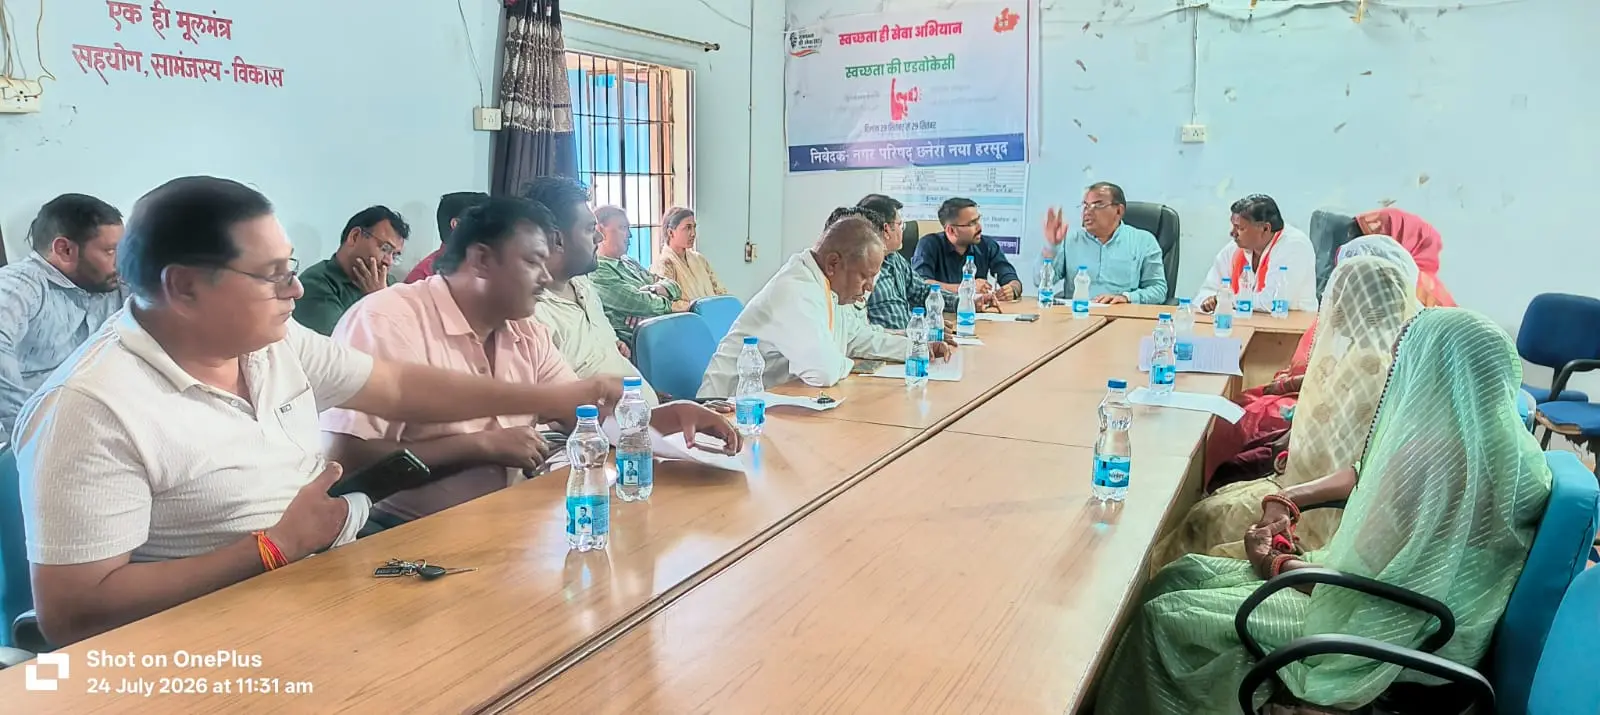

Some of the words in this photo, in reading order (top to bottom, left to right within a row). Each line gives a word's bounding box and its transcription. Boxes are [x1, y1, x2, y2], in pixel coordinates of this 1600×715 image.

[107, 0, 143, 31] एक
[151, 0, 171, 40] ही
[176, 9, 233, 45] मूलमंत्र
[838, 30, 877, 46] स्वच्छता
[879, 24, 889, 43] ही
[891, 24, 912, 41] सेवा
[915, 19, 963, 38] अभियान
[150, 50, 222, 82] सामंजस्य
[232, 55, 285, 88] विकास
[845, 63, 884, 79] स्वच्छता
[886, 57, 902, 75] की
[903, 53, 956, 74] एडवोकेसी
[852, 148, 877, 163] नगर
[948, 143, 972, 157] नया
[974, 141, 1009, 160] हरसूद
